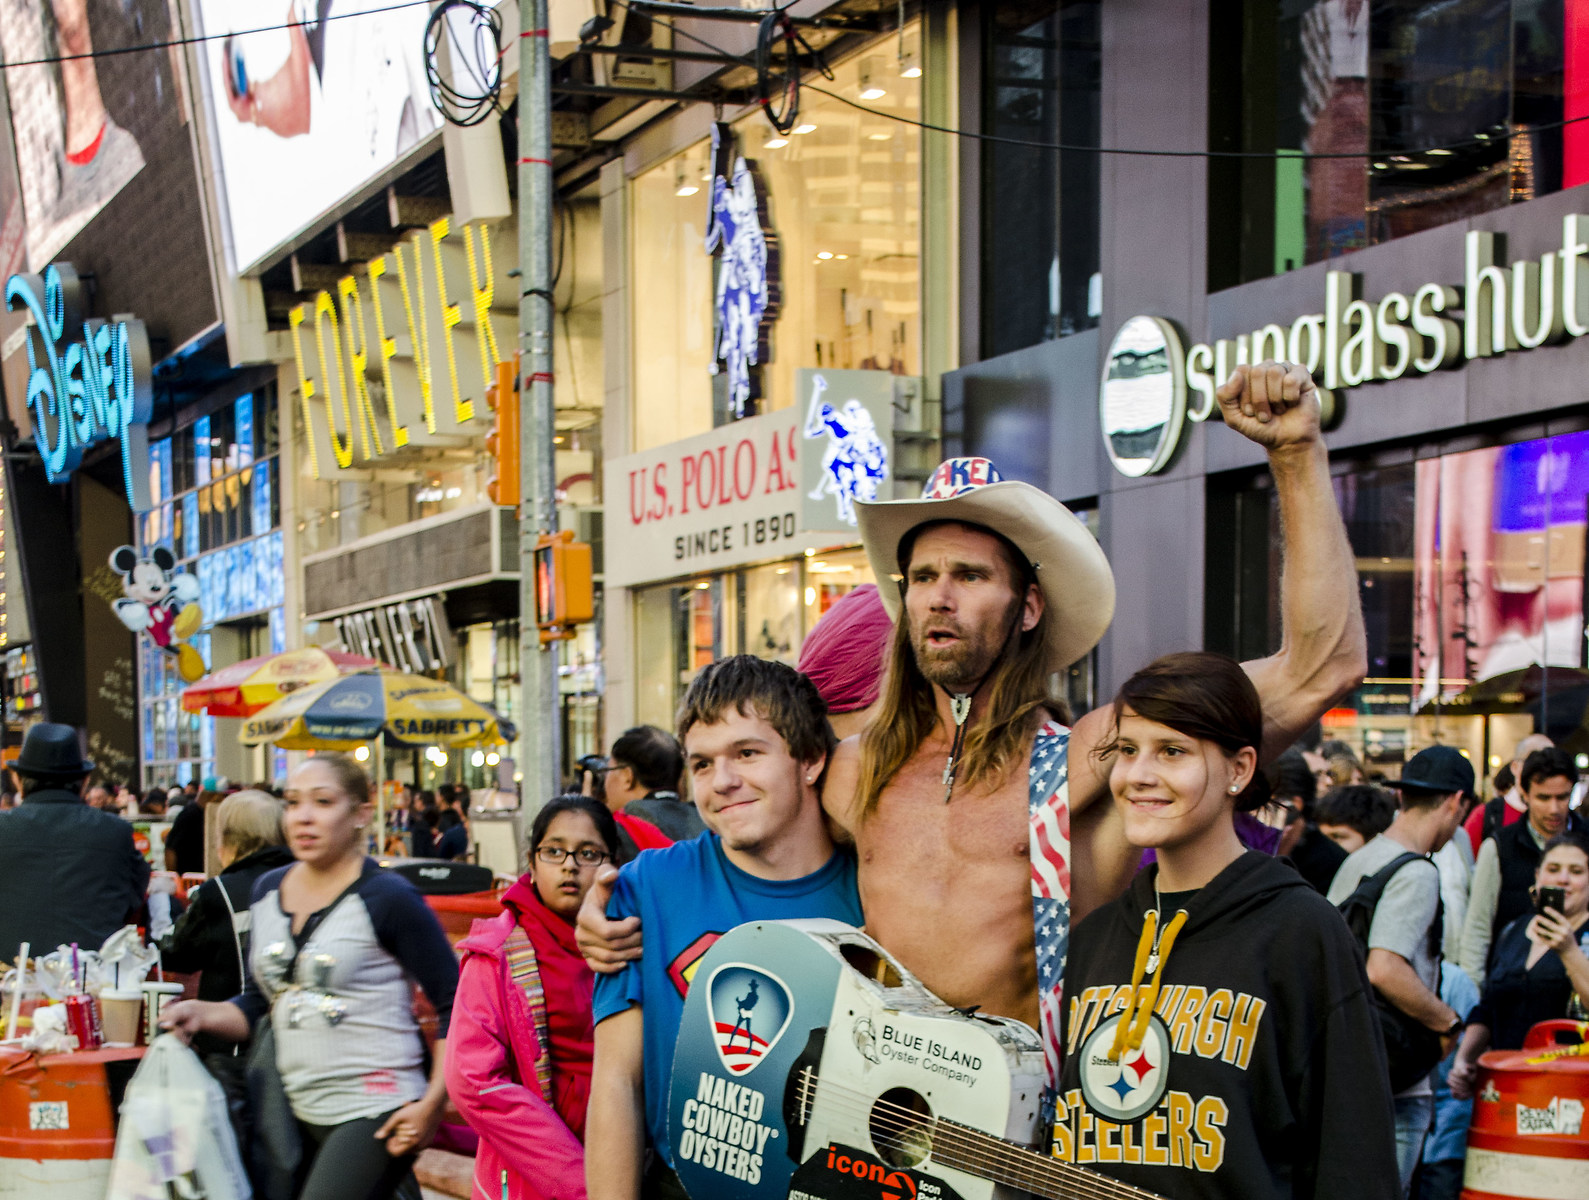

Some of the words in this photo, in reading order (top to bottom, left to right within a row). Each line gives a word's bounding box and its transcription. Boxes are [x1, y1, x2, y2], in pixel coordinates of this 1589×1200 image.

[1464, 213, 1589, 360] hut
[289, 217, 500, 480] FOREVER
[629, 462, 673, 525] U.S.
[680, 438, 757, 514] POLO
[674, 525, 732, 560] SINCE
[743, 512, 796, 546] 1890
[881, 1044, 919, 1066] Oyster
[922, 1058, 977, 1088] Company
[882, 1025, 923, 1051] BLUE
[927, 1040, 982, 1071] ISLAND
[696, 1072, 765, 1122] NAKED
[679, 1129, 764, 1186] OYSTERS
[827, 1146, 886, 1184] icon
[918, 1180, 941, 1195] Icon
